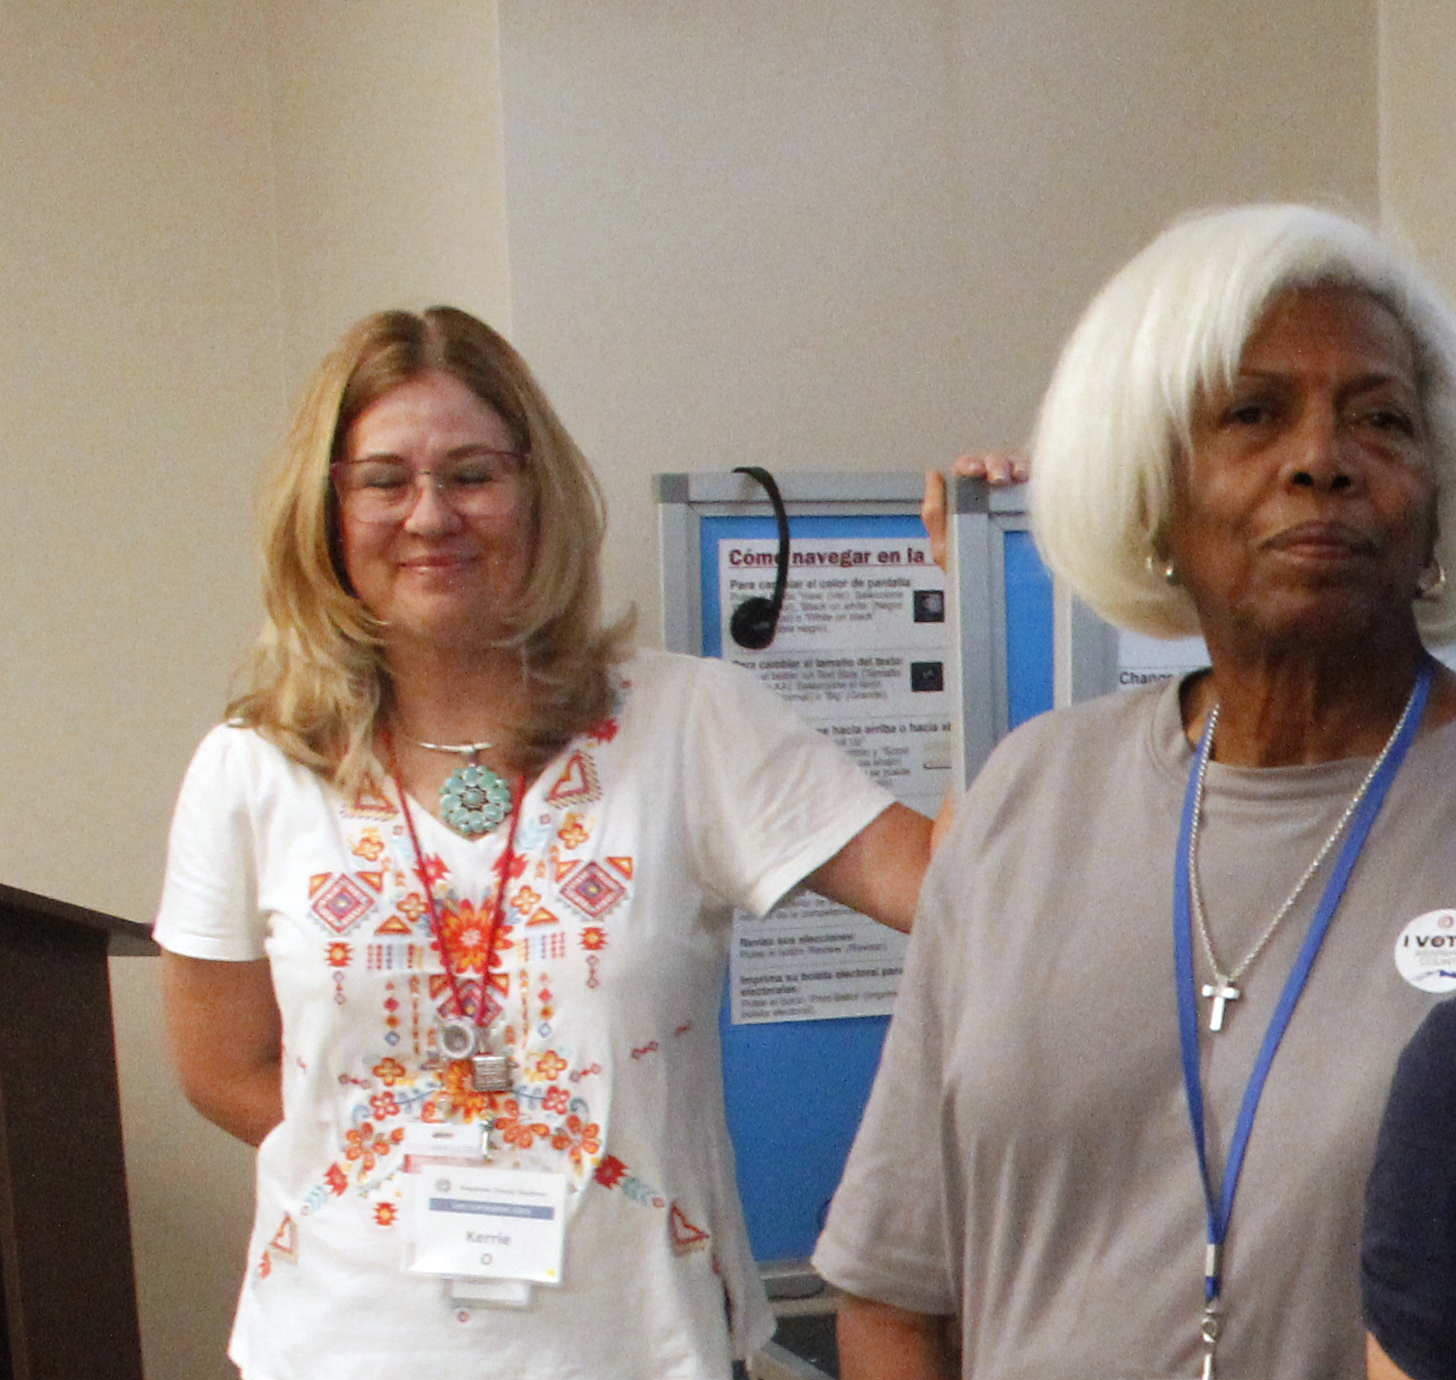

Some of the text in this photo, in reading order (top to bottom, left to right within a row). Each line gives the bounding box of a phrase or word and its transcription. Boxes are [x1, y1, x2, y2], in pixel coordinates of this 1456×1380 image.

[729, 547, 925, 567] Cóm navegar en la
[730, 579, 755, 590] Para
[820, 578, 847, 588] color
[851, 577, 864, 588] de
[1403, 935, 1409, 947] I
